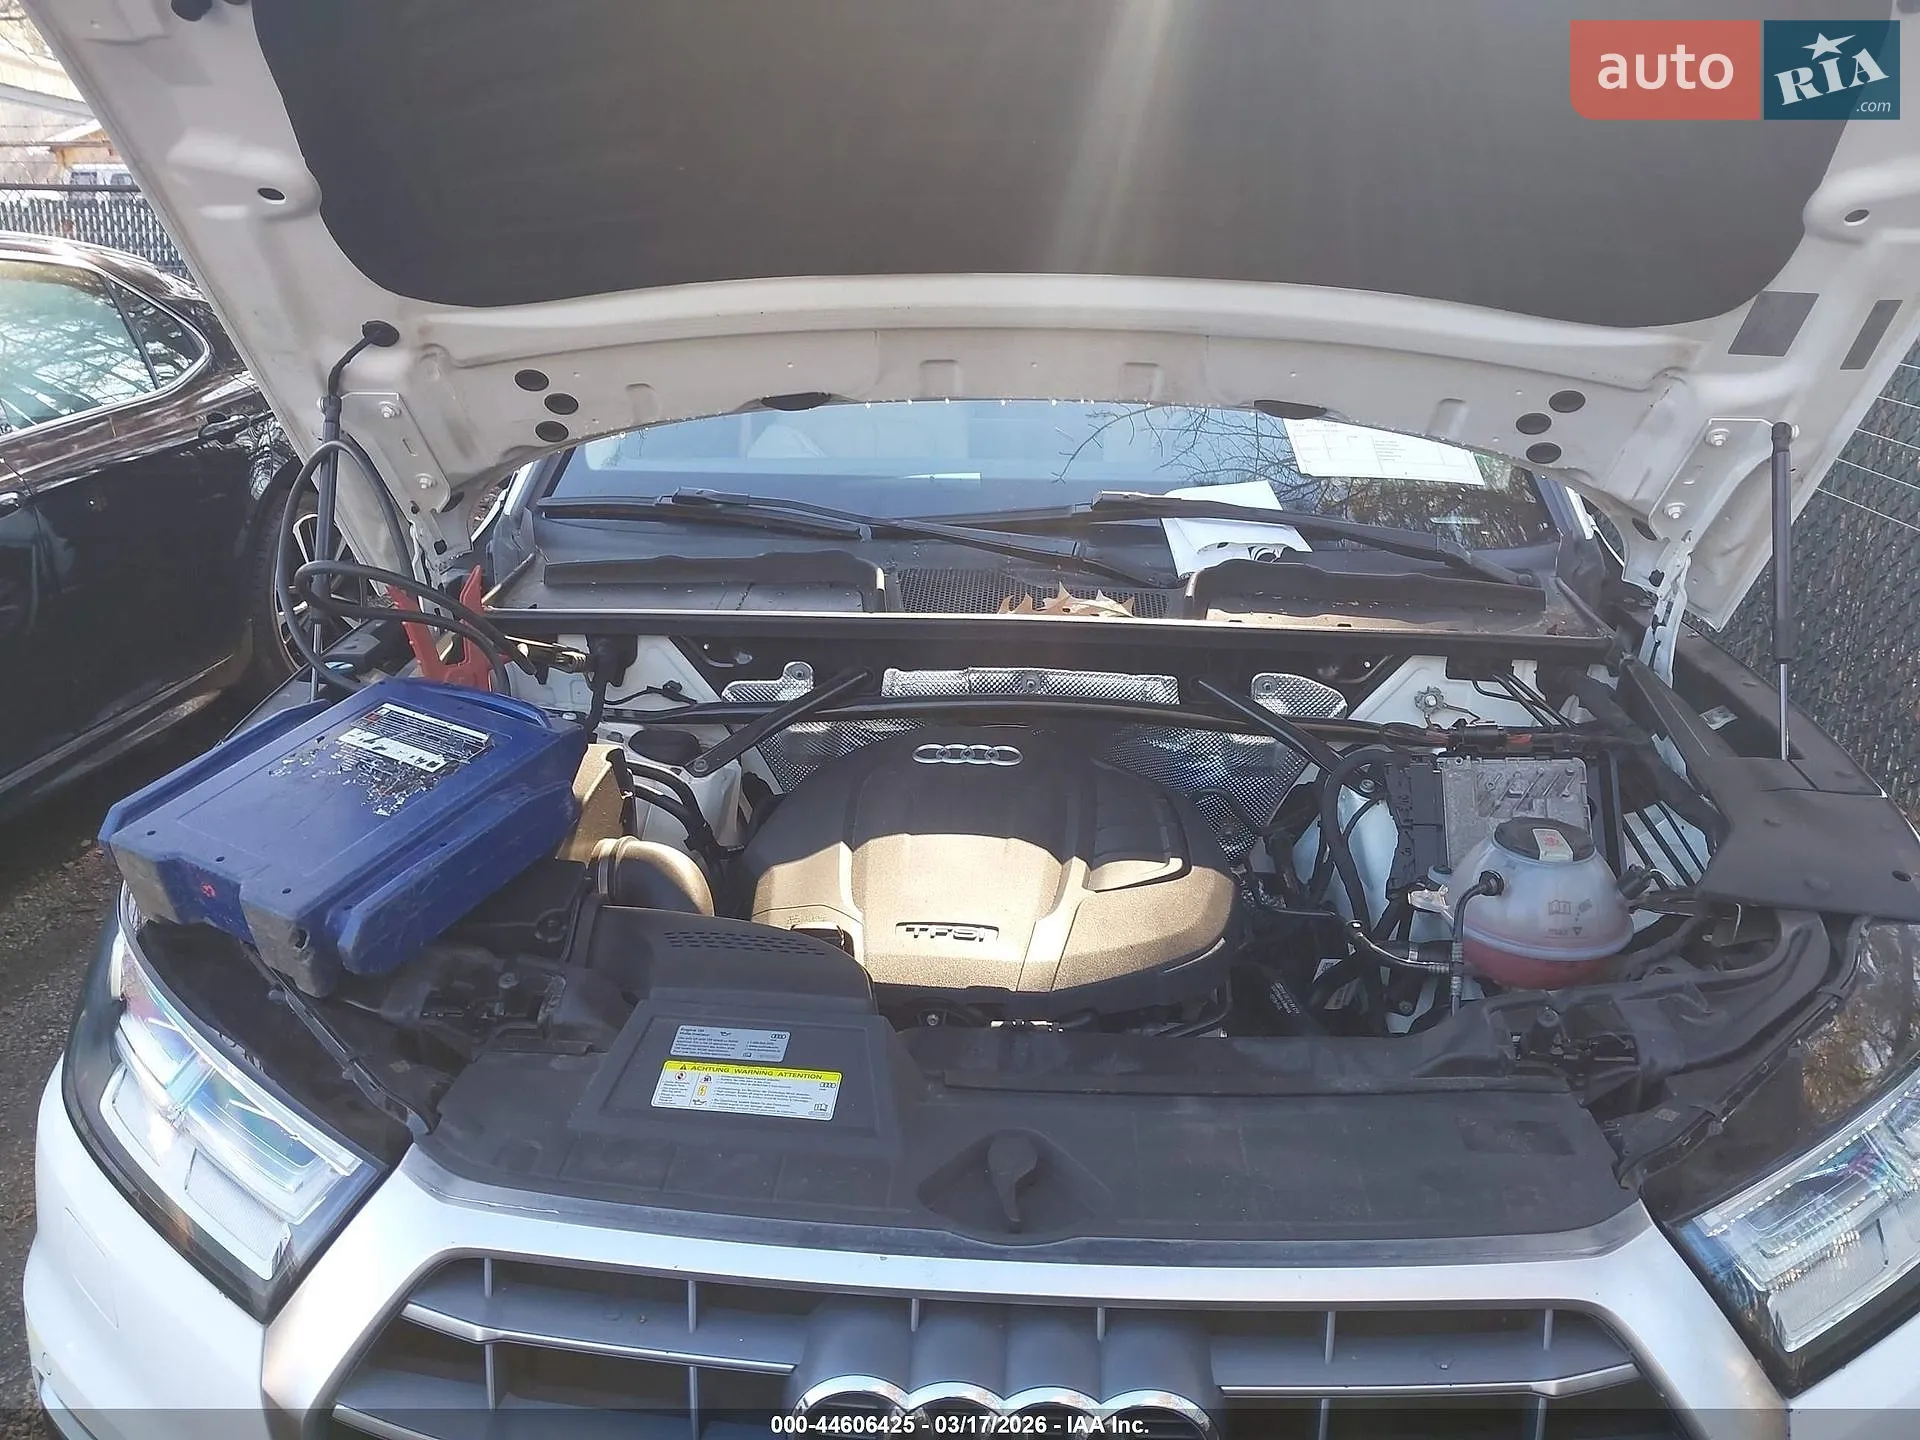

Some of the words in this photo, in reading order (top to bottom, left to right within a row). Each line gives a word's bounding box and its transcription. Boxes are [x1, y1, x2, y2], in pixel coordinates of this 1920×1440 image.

[691, 1065, 730, 1074] ACHTUNG
[734, 1068, 774, 1077] WARNING
[778, 1070, 823, 1080] ATTENTION
